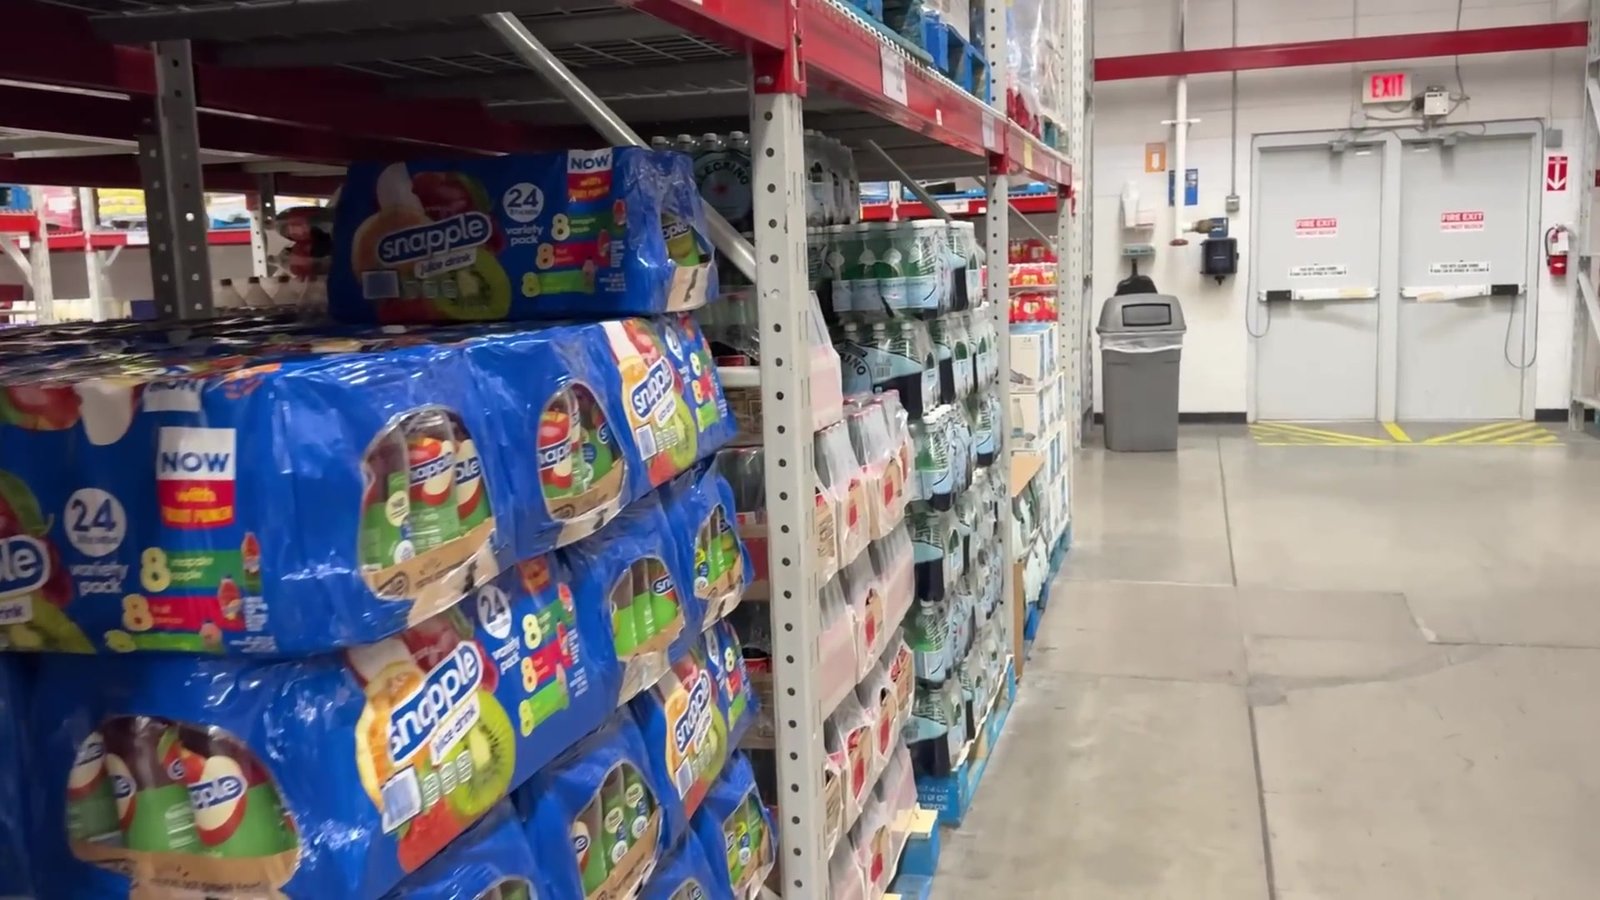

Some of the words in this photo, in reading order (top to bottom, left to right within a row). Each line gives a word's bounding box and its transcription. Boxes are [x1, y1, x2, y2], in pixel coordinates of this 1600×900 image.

[1372, 74, 1404, 98] EXIT
[570, 154, 610, 170] NOW
[507, 188, 539, 208] 24
[505, 224, 545, 235] variety
[551, 213, 571, 241] 8
[1296, 219, 1315, 228] FIRE
[1316, 218, 1336, 228] EXIT
[1441, 212, 1461, 222] FIRE
[1462, 211, 1484, 221] EXIT
[382, 214, 484, 259] snapple
[510, 235, 539, 247] pack
[536, 243, 555, 270] 8
[522, 272, 541, 298] 8
[160, 452, 231, 473] NOW
[71, 498, 117, 532] 24
[69, 560, 130, 580] variety
[141, 546, 171, 593] 8
[79, 578, 122, 598] pack
[122, 593, 154, 632] 8
[480, 589, 505, 624] 24
[522, 613, 542, 650] 8
[724, 646, 735, 673] 8
[521, 656, 538, 693] 8
[390, 651, 478, 757] snapple
[519, 699, 533, 738] 8
